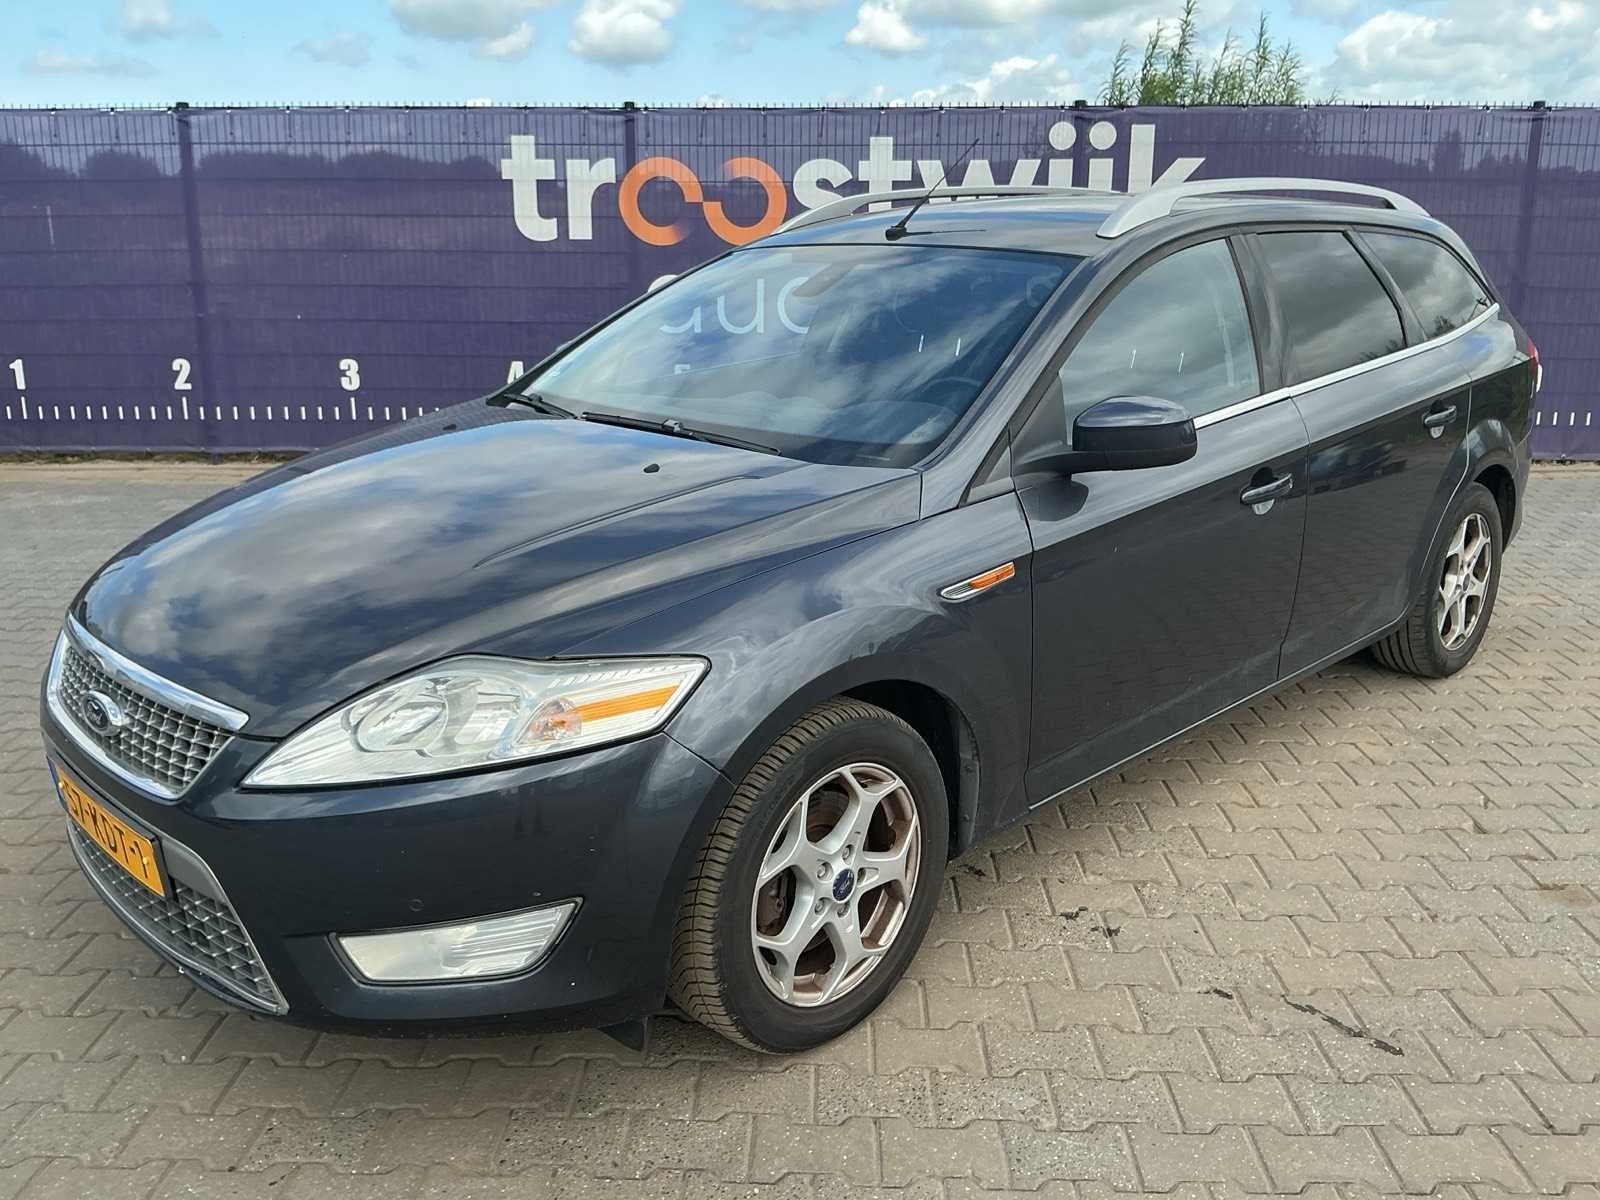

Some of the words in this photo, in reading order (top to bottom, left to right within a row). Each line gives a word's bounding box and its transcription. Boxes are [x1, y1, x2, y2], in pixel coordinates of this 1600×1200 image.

[9, 359, 26, 390] 1
[172, 358, 192, 390] 2
[339, 358, 361, 391] 3
